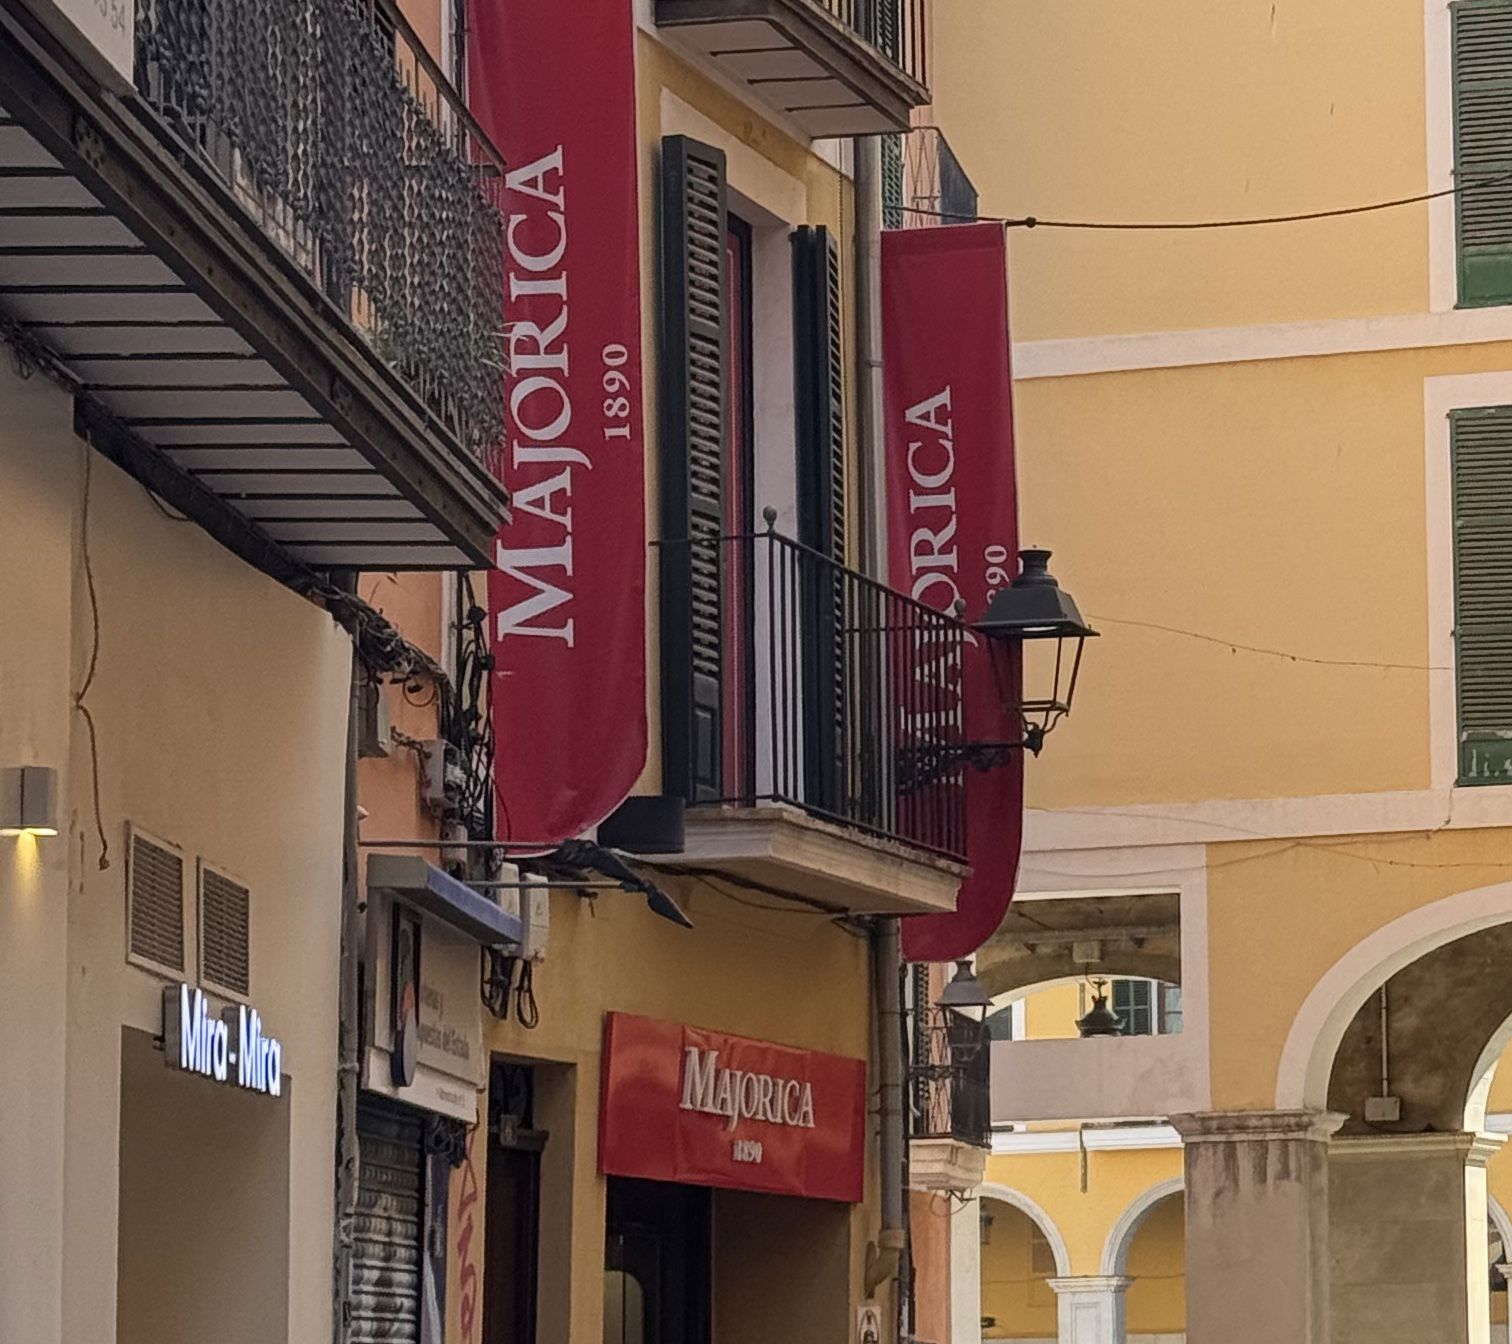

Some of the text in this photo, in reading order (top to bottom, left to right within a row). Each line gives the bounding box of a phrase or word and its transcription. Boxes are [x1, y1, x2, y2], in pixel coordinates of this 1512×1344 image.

[496, 144, 593, 648] MAJORICA
[602, 342, 632, 441] 1890
[984, 544, 1008, 606] 90
[733, 1140, 763, 1164] 1890
